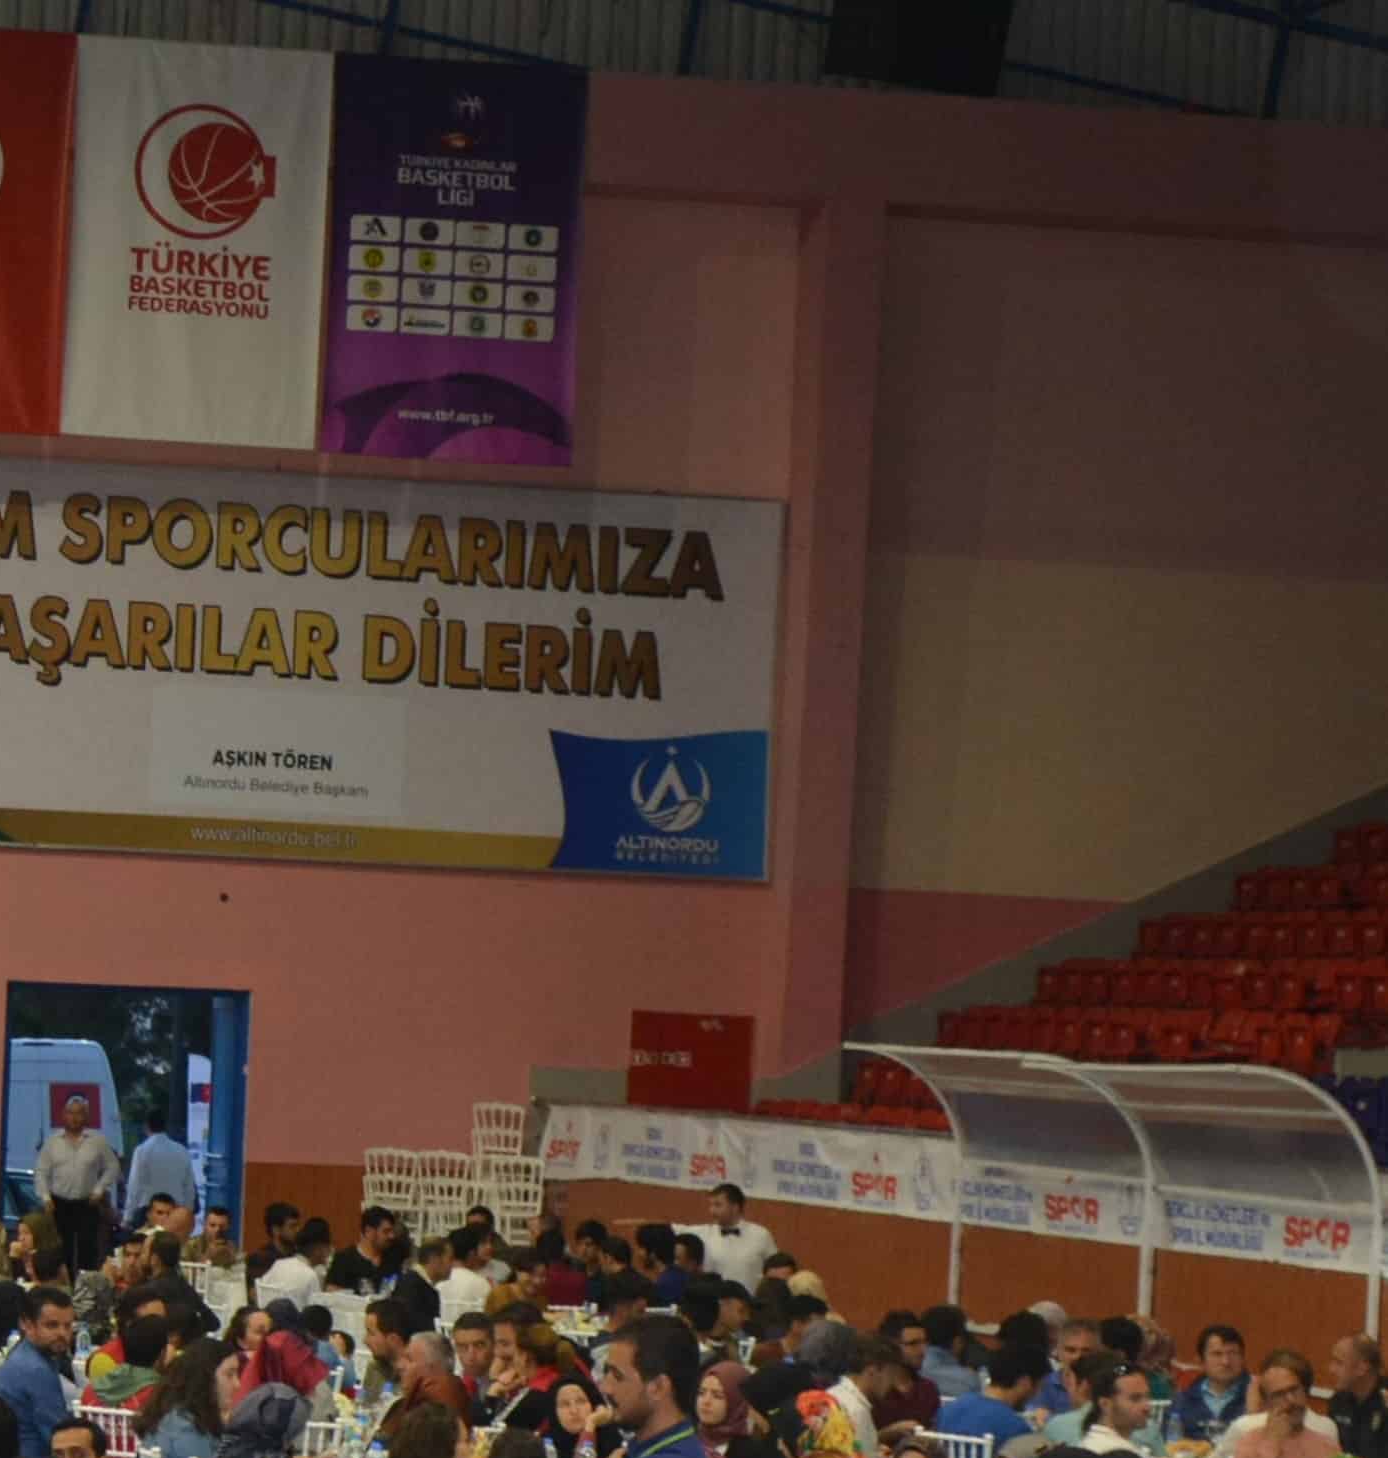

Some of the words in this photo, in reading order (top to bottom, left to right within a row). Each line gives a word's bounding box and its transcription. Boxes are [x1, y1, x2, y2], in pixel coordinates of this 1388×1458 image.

[397, 167, 516, 191] BASKETBOL
[129, 241, 271, 280] TÜRKİYE
[129, 275, 270, 302] BASKETBOL
[128, 296, 269, 319] FEDERASYONU
[58, 493, 725, 602] SPORCULARIMIZA
[362, 597, 662, 701] DİLERİM
[213, 749, 267, 769] AŞKIN
[272, 747, 333, 771] TÖREN
[250, 778, 308, 796] Belediye
[616, 835, 719, 852] ALTINORDU
